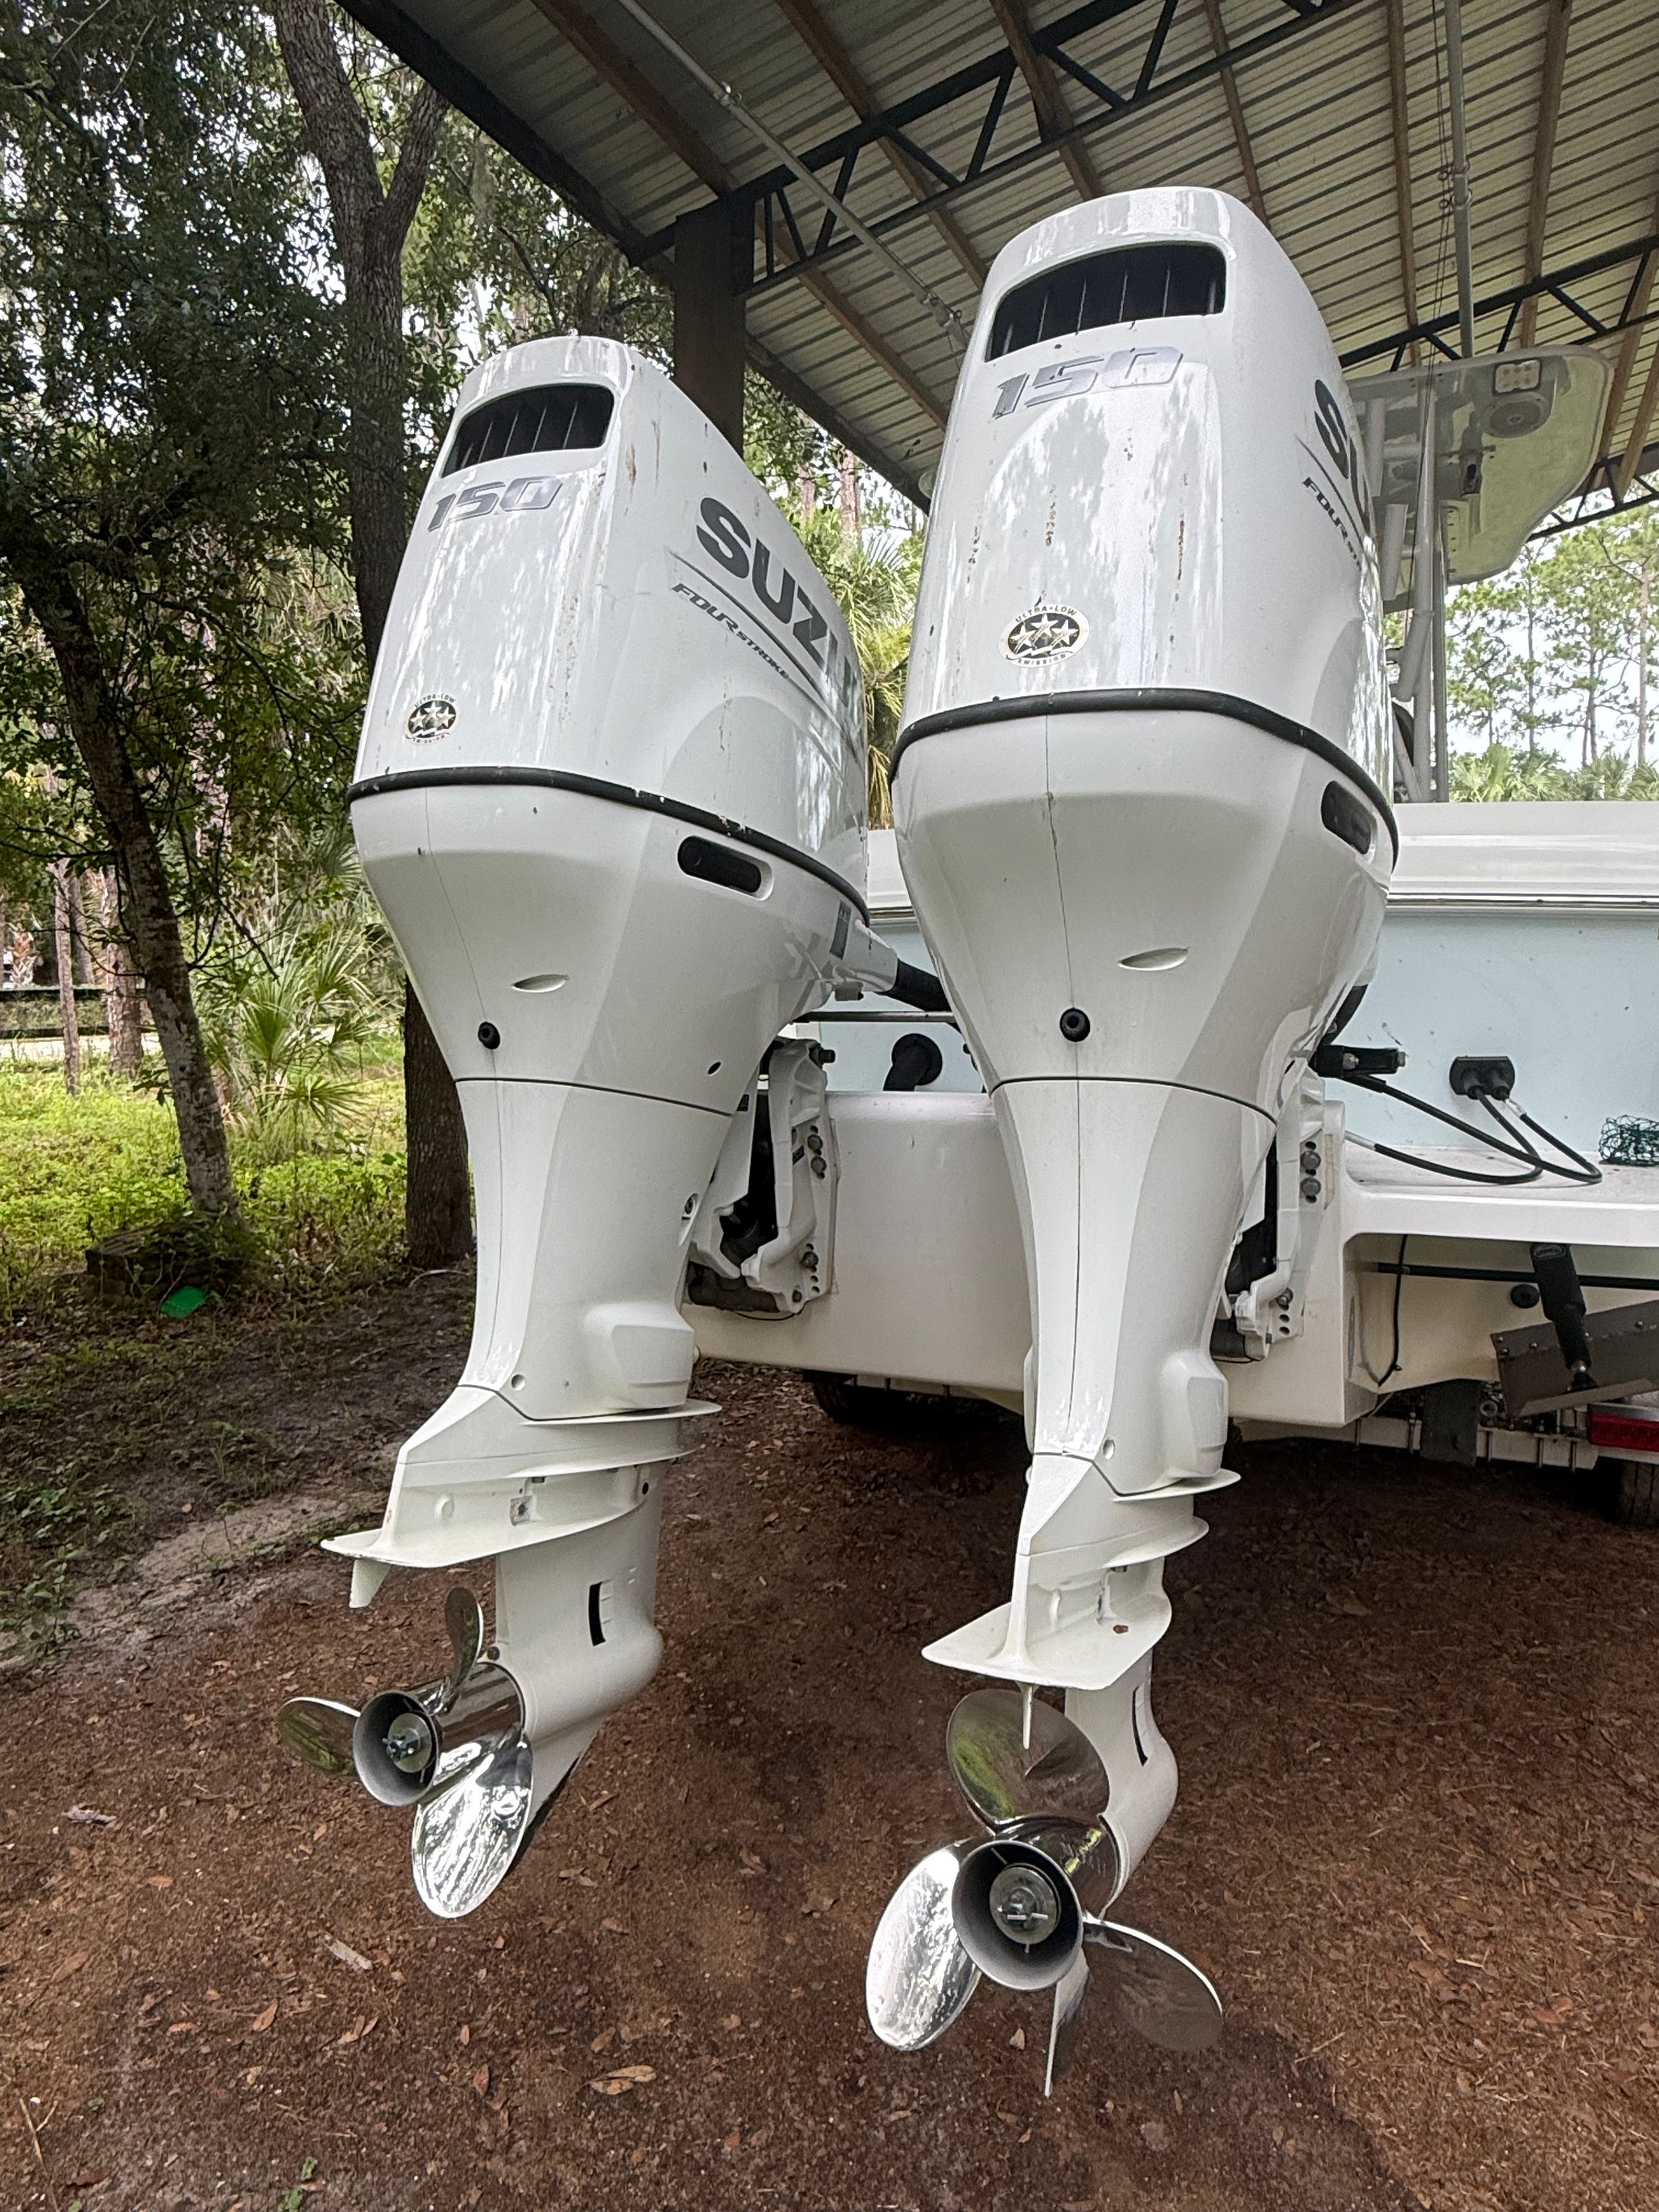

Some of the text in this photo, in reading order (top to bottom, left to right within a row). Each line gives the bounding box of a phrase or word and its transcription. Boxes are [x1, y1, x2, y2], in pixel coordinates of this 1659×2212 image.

[991, 346, 1184, 420] 150
[427, 476, 563, 532] 150
[672, 583, 789, 679] FOUR STROKE
